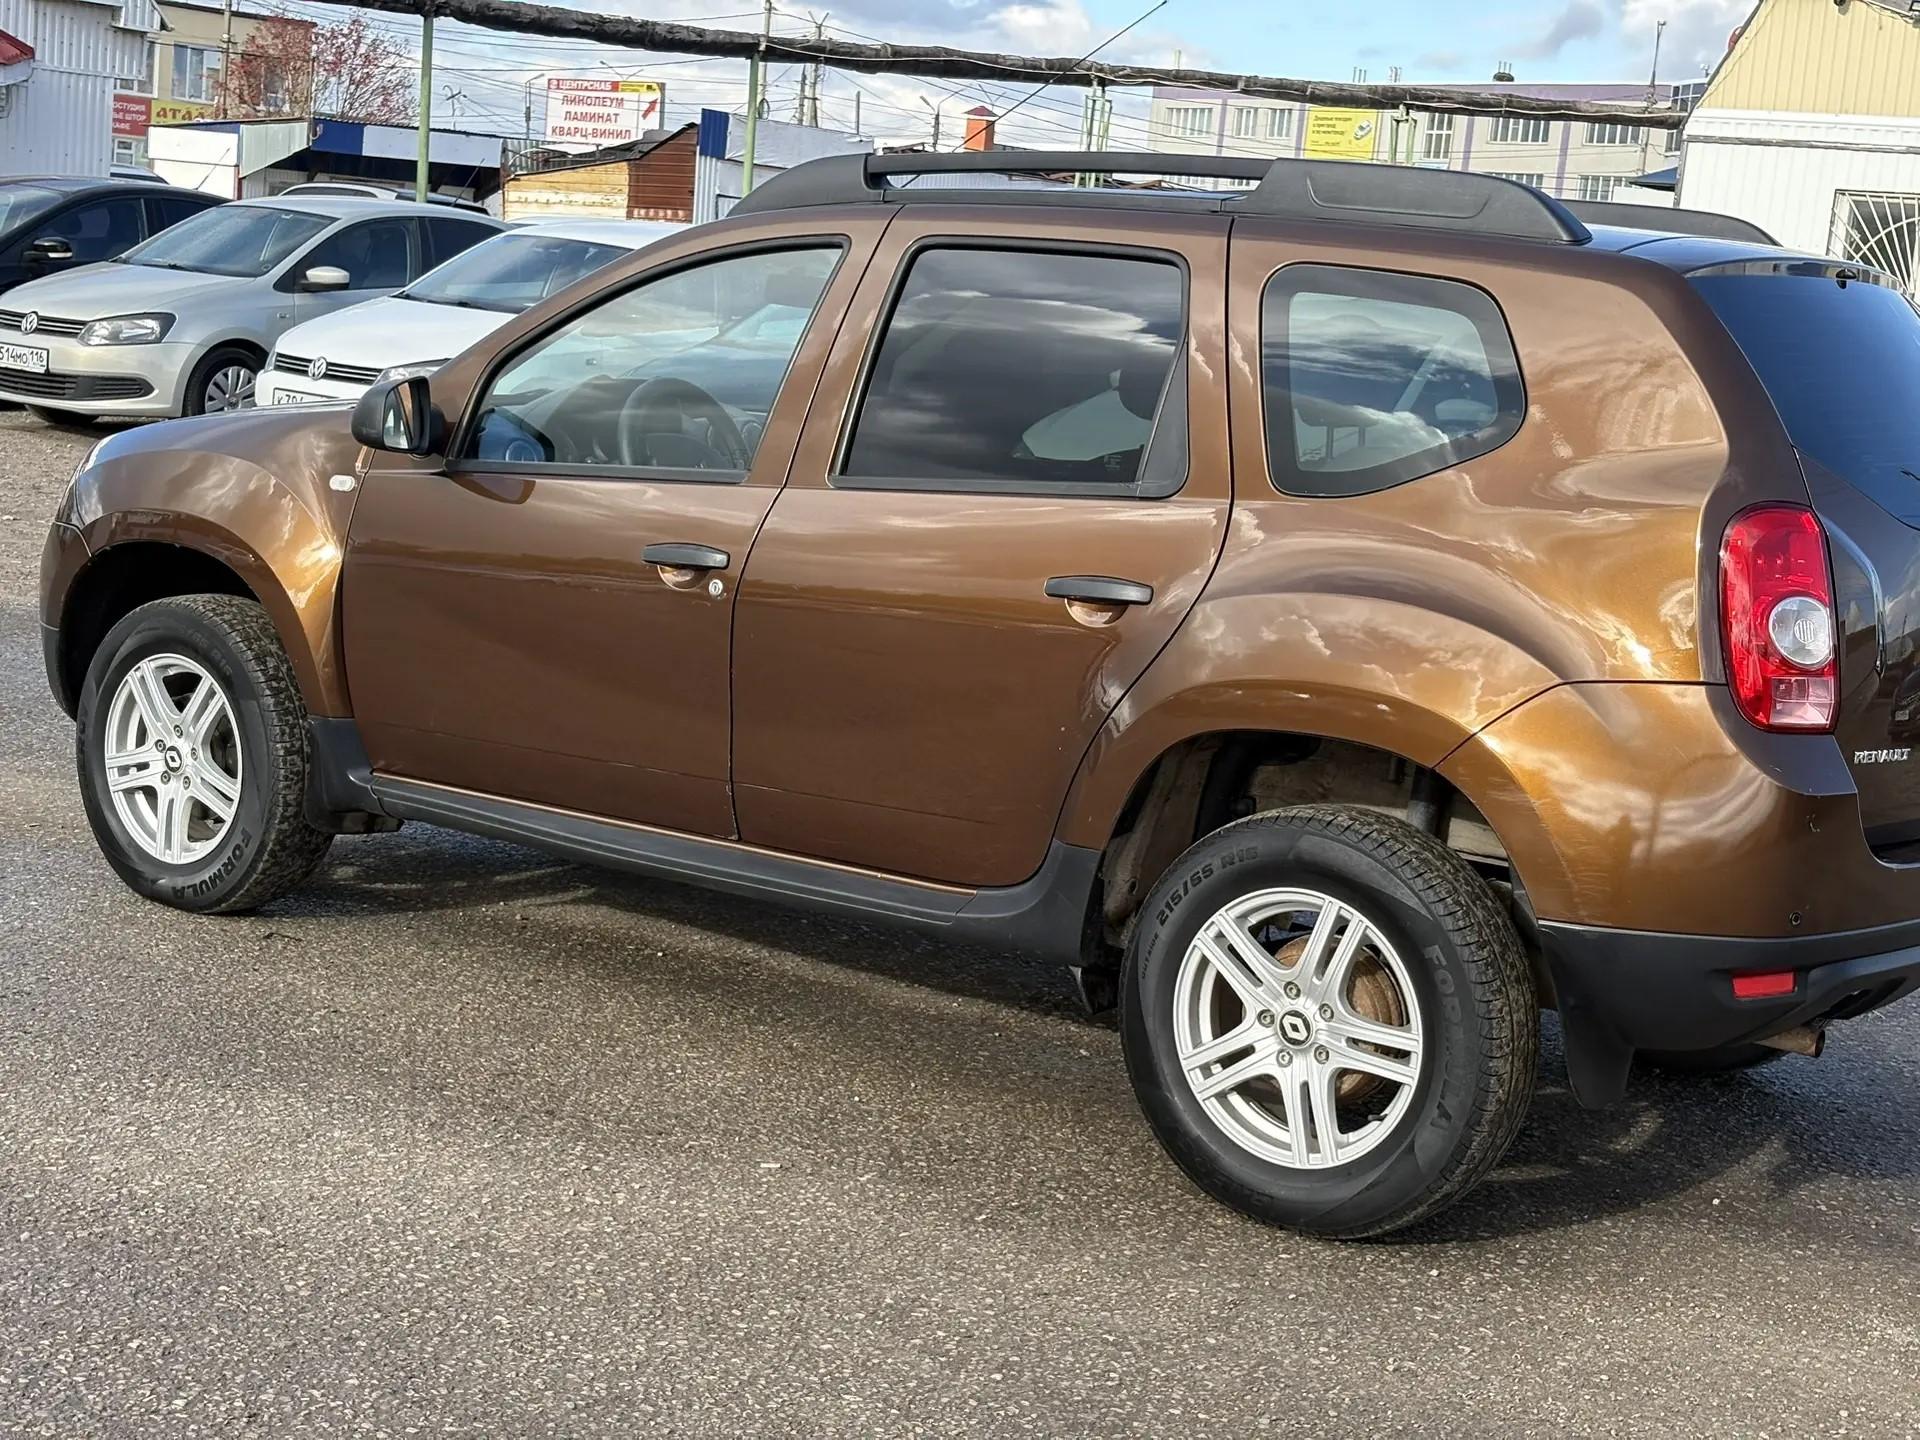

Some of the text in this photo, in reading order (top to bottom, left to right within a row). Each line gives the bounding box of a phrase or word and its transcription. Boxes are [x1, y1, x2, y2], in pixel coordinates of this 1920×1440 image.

[561, 95, 624, 108] ЛИНОЛЕУМ
[564, 111, 620, 123] ЛАМИНАТ
[551, 126, 632, 140] КВАРЦ-ВИНИЛ
[1854, 748, 1911, 764] RENAULT
[171, 827, 252, 900] FORMULA
[1156, 863, 1214, 927] 215/65
